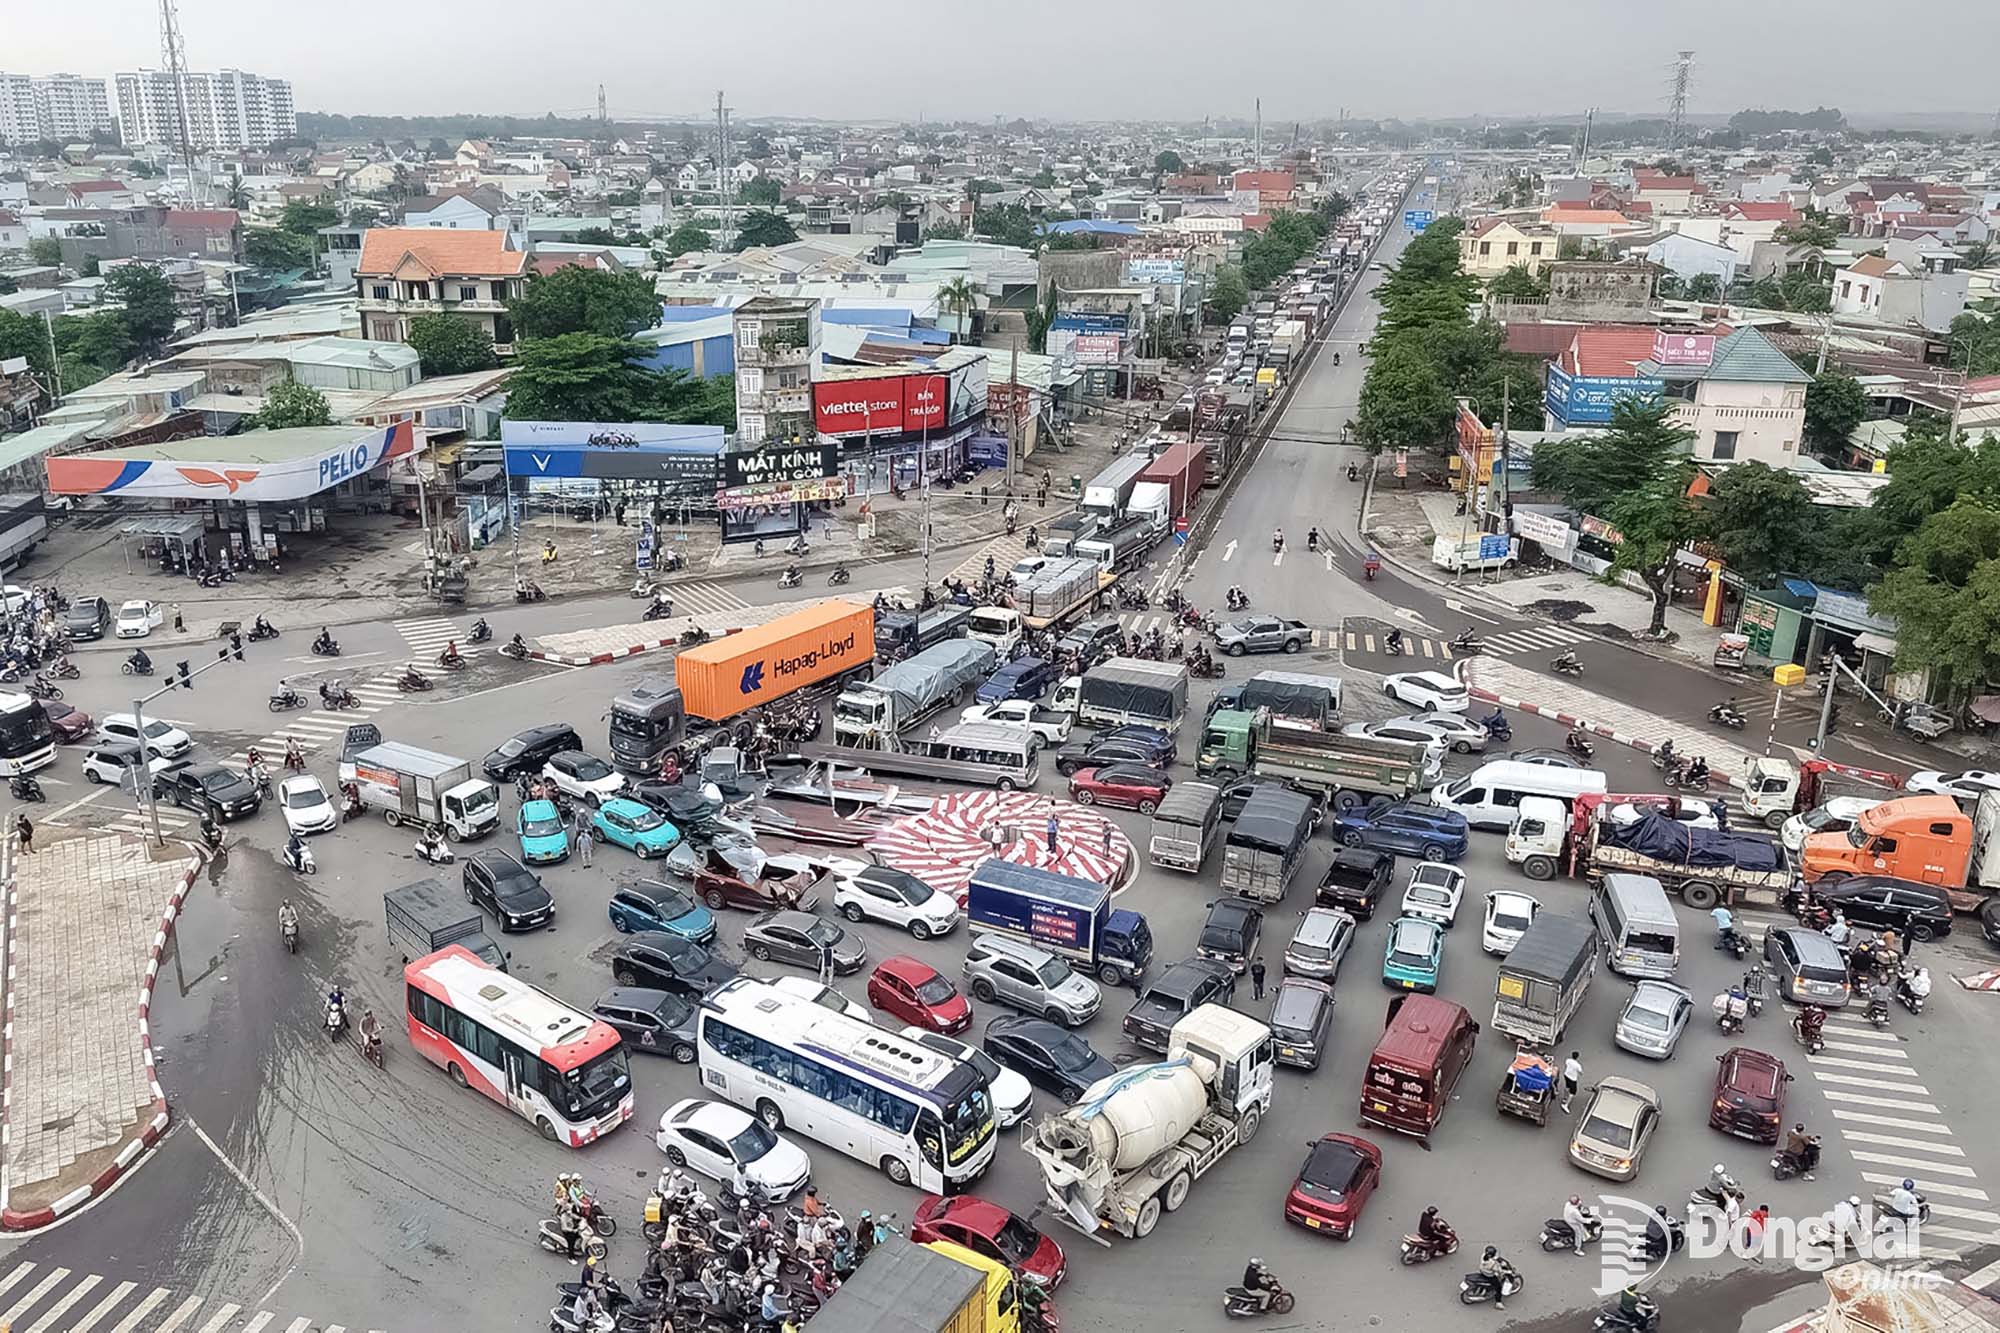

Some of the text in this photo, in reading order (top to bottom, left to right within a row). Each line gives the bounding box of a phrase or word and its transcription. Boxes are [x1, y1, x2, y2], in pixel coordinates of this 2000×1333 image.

[821, 400, 898, 415] viettel store
[319, 445, 368, 486] PELIO
[737, 449, 822, 473] MẮT KÍNH
[774, 633, 854, 679] Hapag-Lloyd
